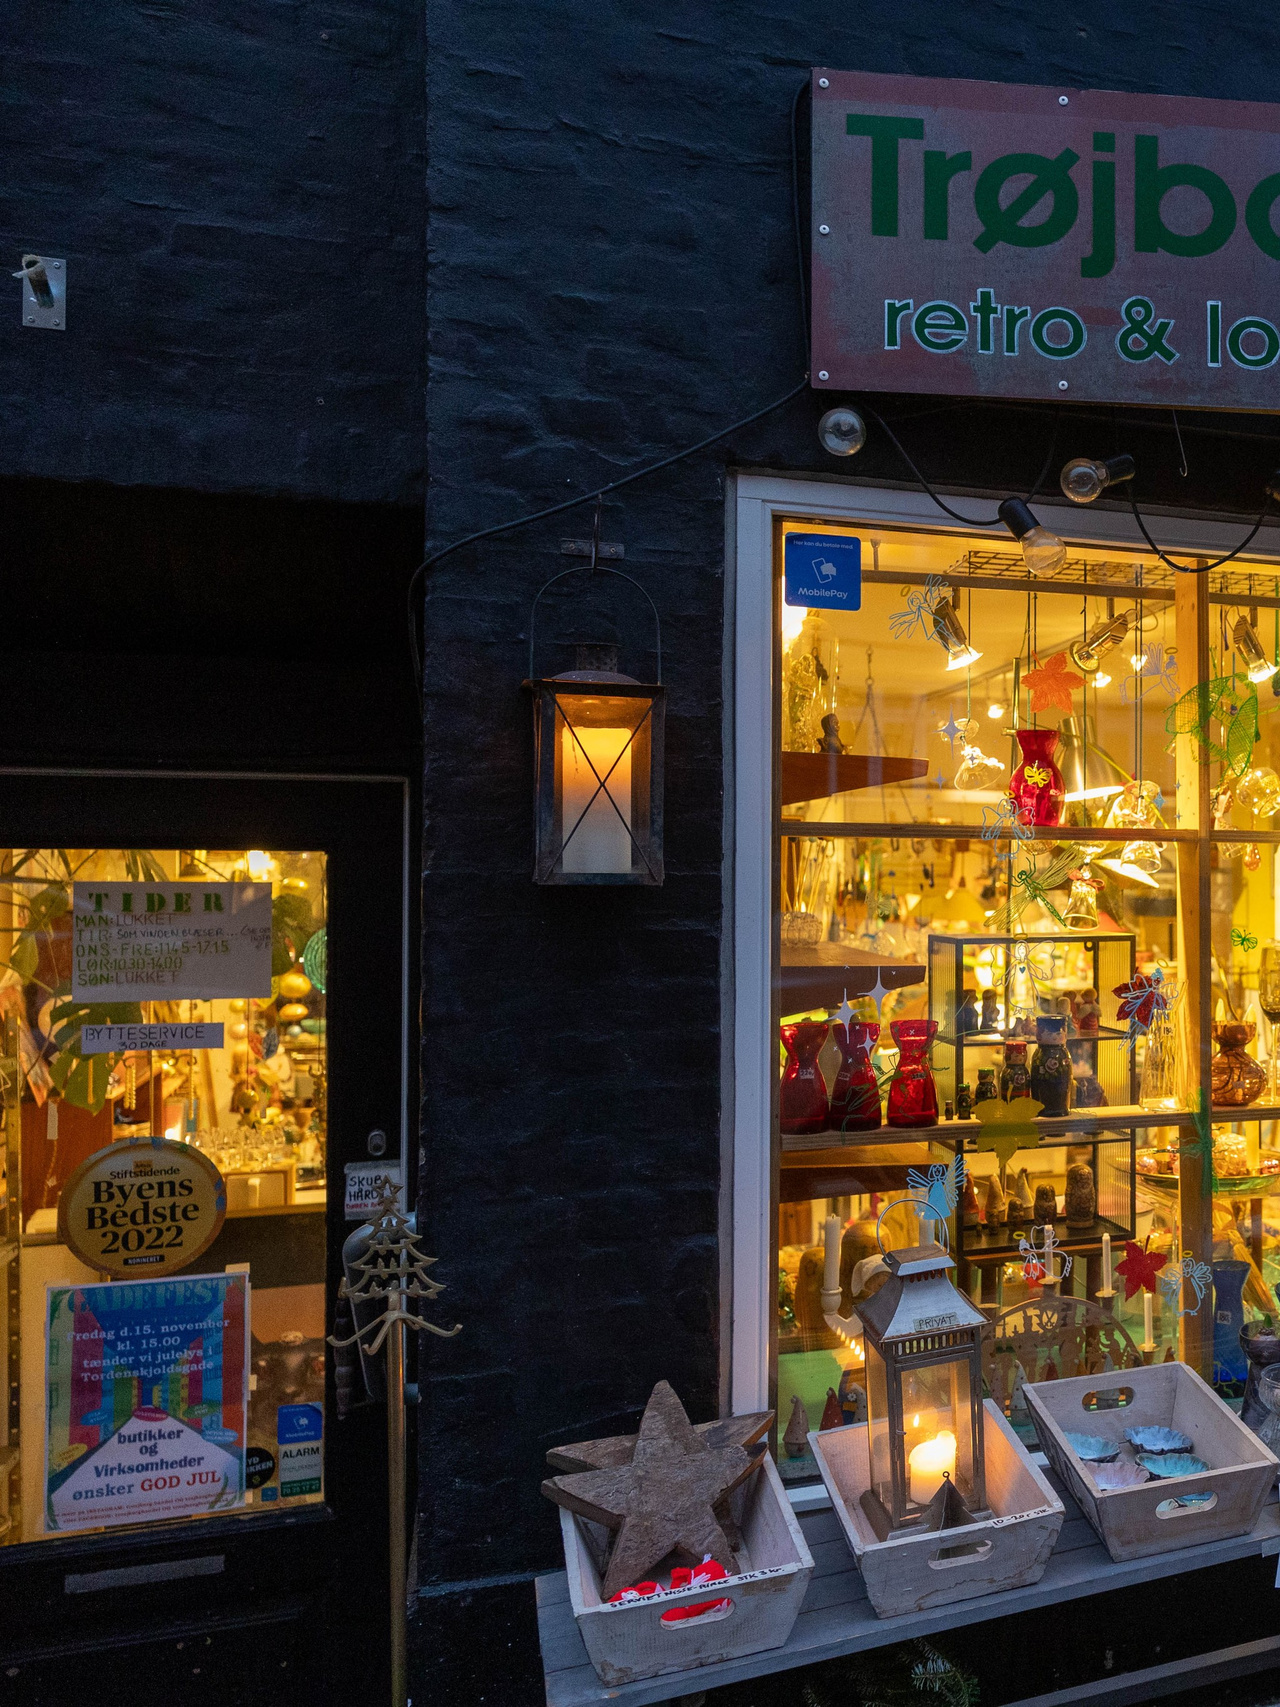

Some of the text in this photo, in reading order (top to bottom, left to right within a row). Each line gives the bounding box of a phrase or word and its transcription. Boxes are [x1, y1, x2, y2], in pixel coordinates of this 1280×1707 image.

[883, 288, 1088, 359] retro
[1115, 295, 1180, 366] &
[797, 587, 848, 600] MobilePay
[88, 892, 225, 913] TIDER
[85, 1026, 205, 1041] BYTTESERVICE
[118, 1040, 167, 1050] 30 DAGE
[109, 1166, 181, 1180] Stiftstidende
[91, 1178, 194, 1207] Byens
[86, 1200, 200, 1230] Bedste
[100, 1225, 184, 1255] 2022
[161, 1319, 230, 1333] november
[918, 1315, 955, 1330] PRIVAT
[141, 1336, 181, 1349] 15.00
[83, 1355, 135, 1368] tænder
[139, 1354, 151, 1363] vi
[155, 1348, 204, 1364] julelys
[81, 1361, 214, 1383] Tordenskjoldsgade
[117, 1428, 184, 1445] butikker
[139, 1442, 159, 1457] og
[282, 1447, 320, 1459] ALARM
[94, 1455, 205, 1479] Virksomheder
[73, 1471, 221, 1501] ønsker GOD JUL
[737, 1573, 758, 1582] STK
